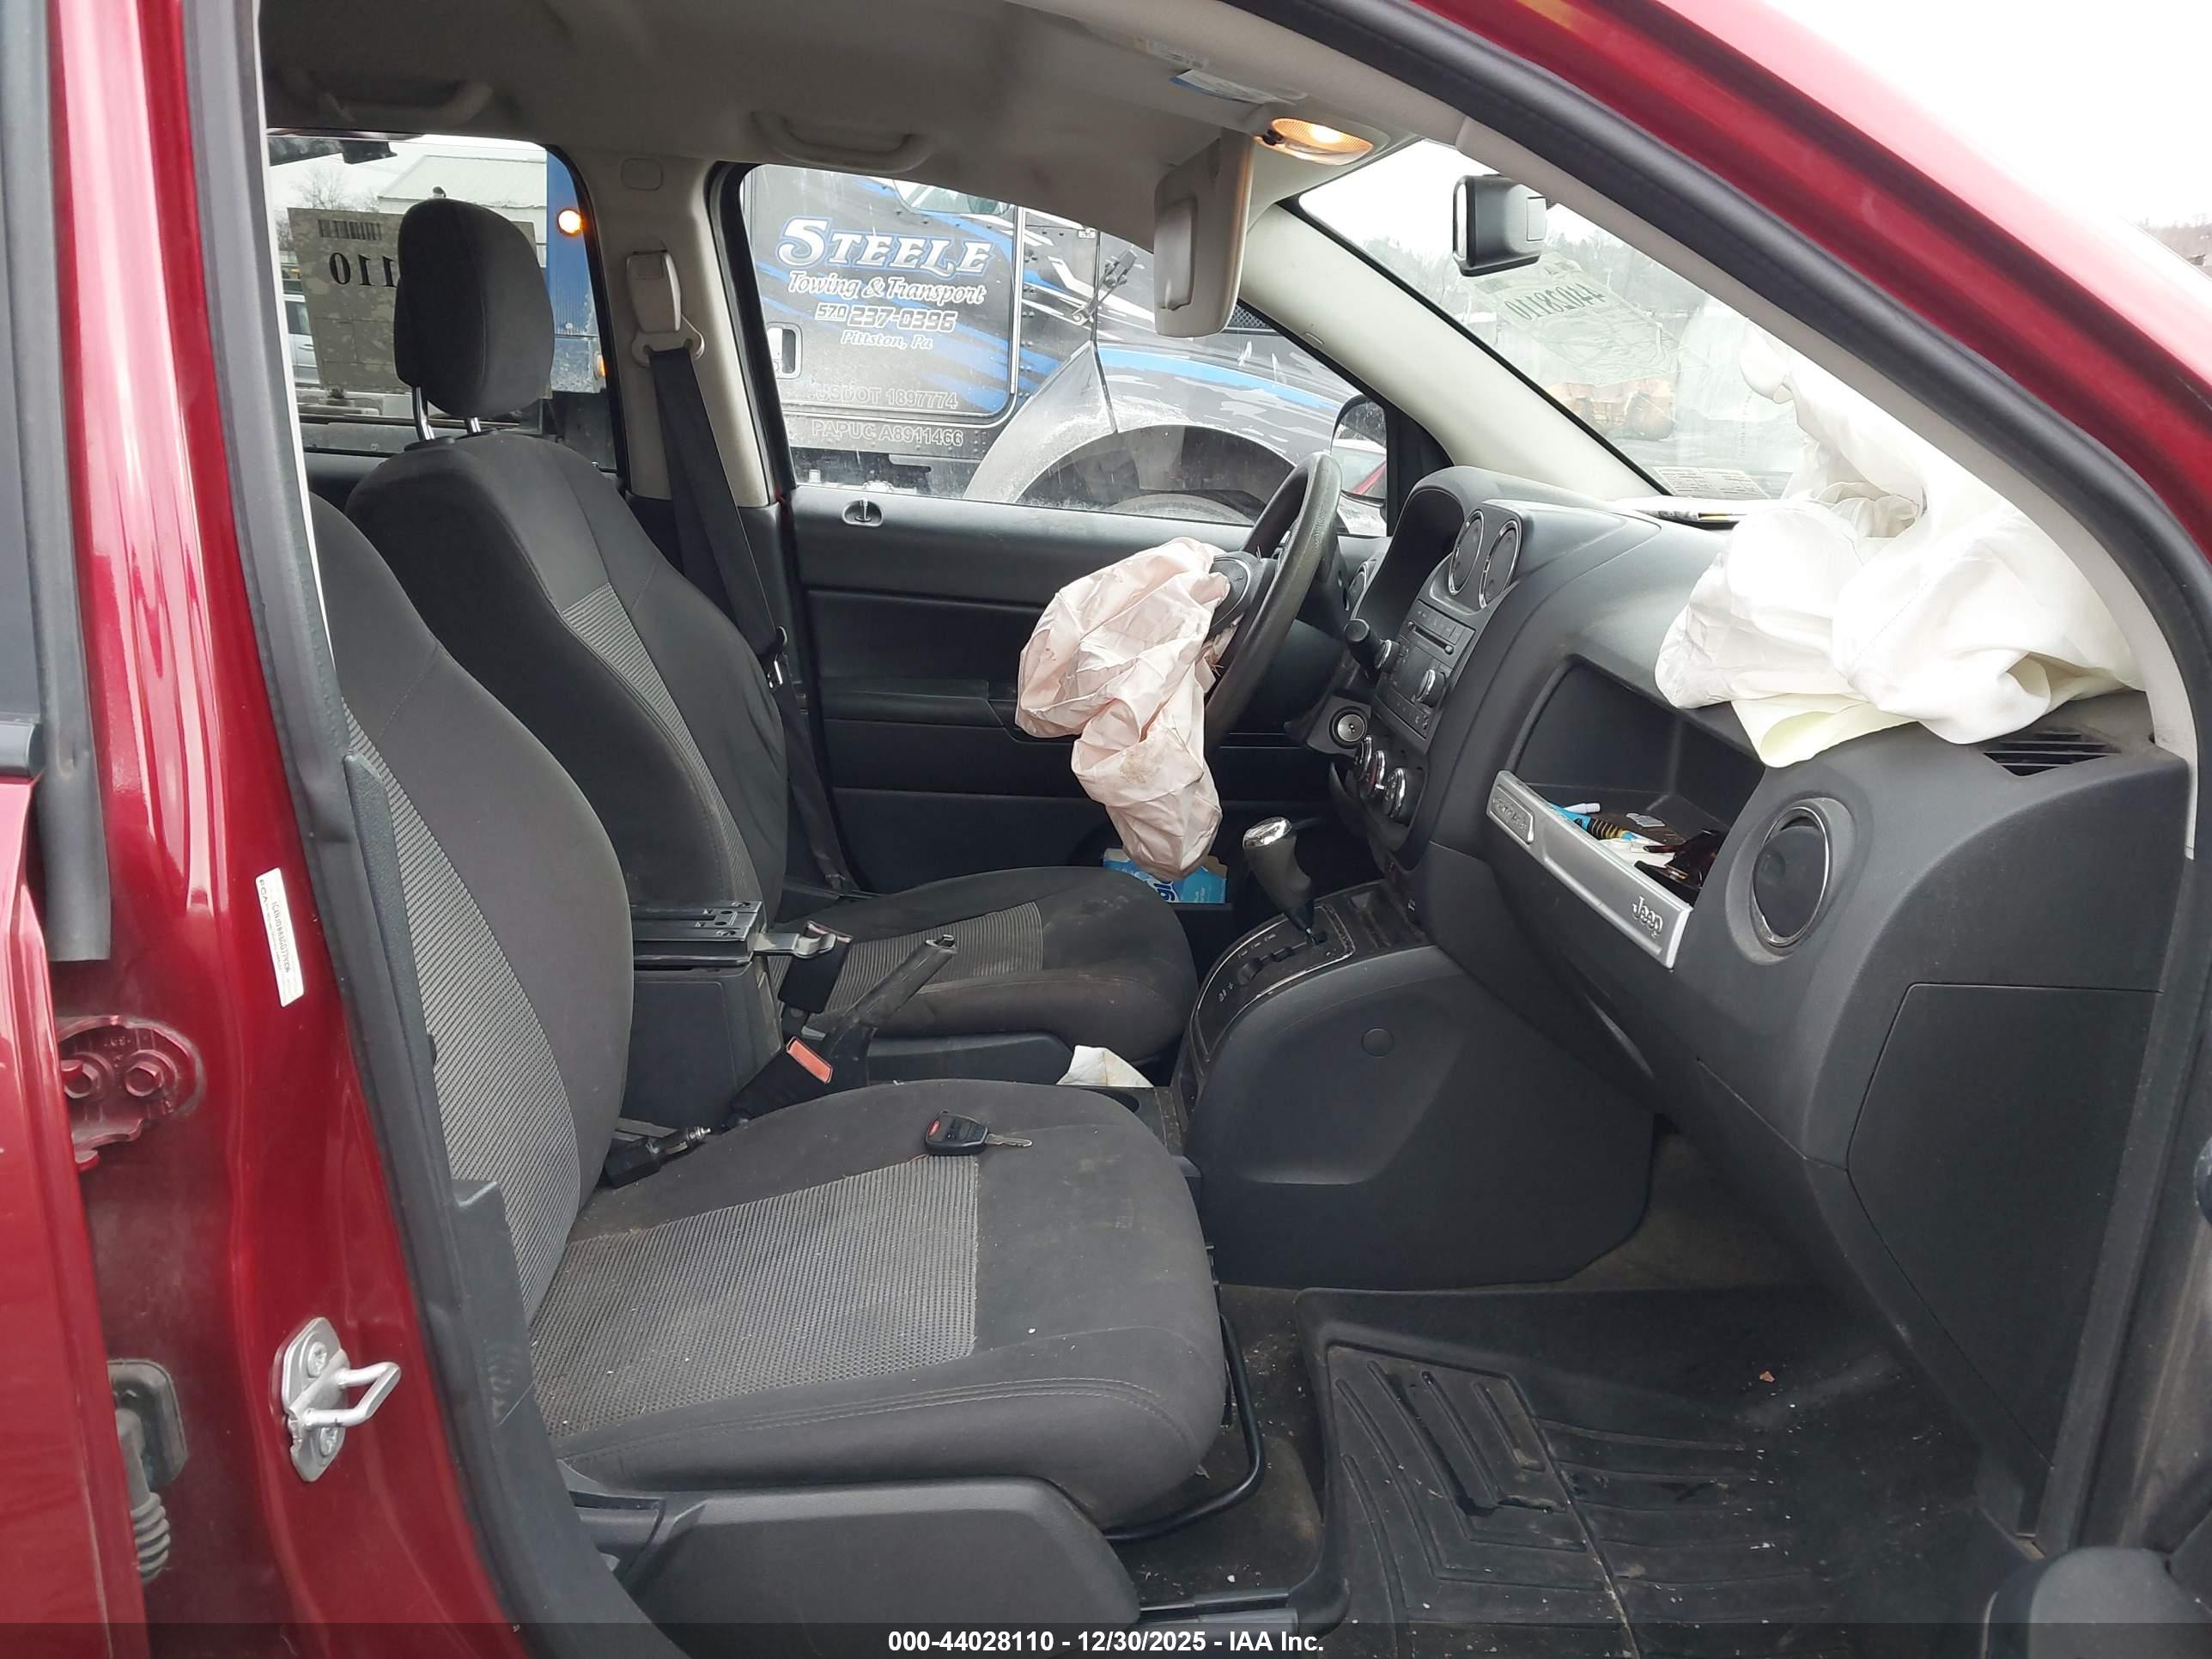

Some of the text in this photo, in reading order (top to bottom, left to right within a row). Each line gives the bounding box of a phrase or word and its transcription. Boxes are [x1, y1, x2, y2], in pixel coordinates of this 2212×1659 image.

[777, 218, 993, 277] STEELE
[788, 270, 986, 304] Towing & Transport
[815, 303, 957, 332] 570 237-0396
[842, 330, 933, 349] Pittston, Pa
[886, 388, 957, 410] 1897774
[811, 419, 963, 447] PAPUC A8911466
[1632, 896, 1664, 938] Jeep
